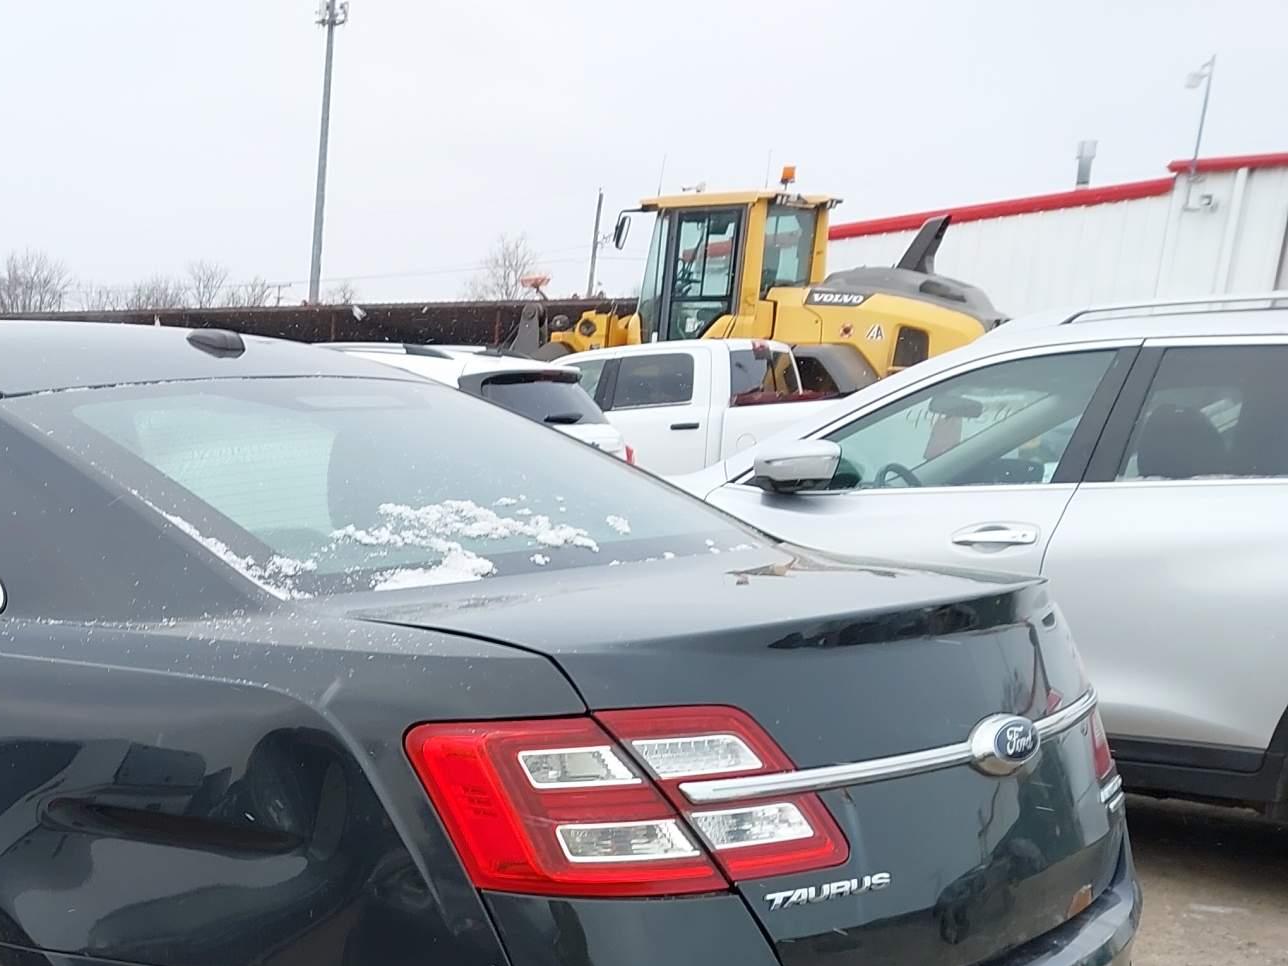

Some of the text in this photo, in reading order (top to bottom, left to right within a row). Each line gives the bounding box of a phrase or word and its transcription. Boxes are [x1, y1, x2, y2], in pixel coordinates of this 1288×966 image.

[812, 293, 864, 304] VOLVO
[1005, 725, 1036, 755] Ford
[763, 871, 893, 911] TAURUS
